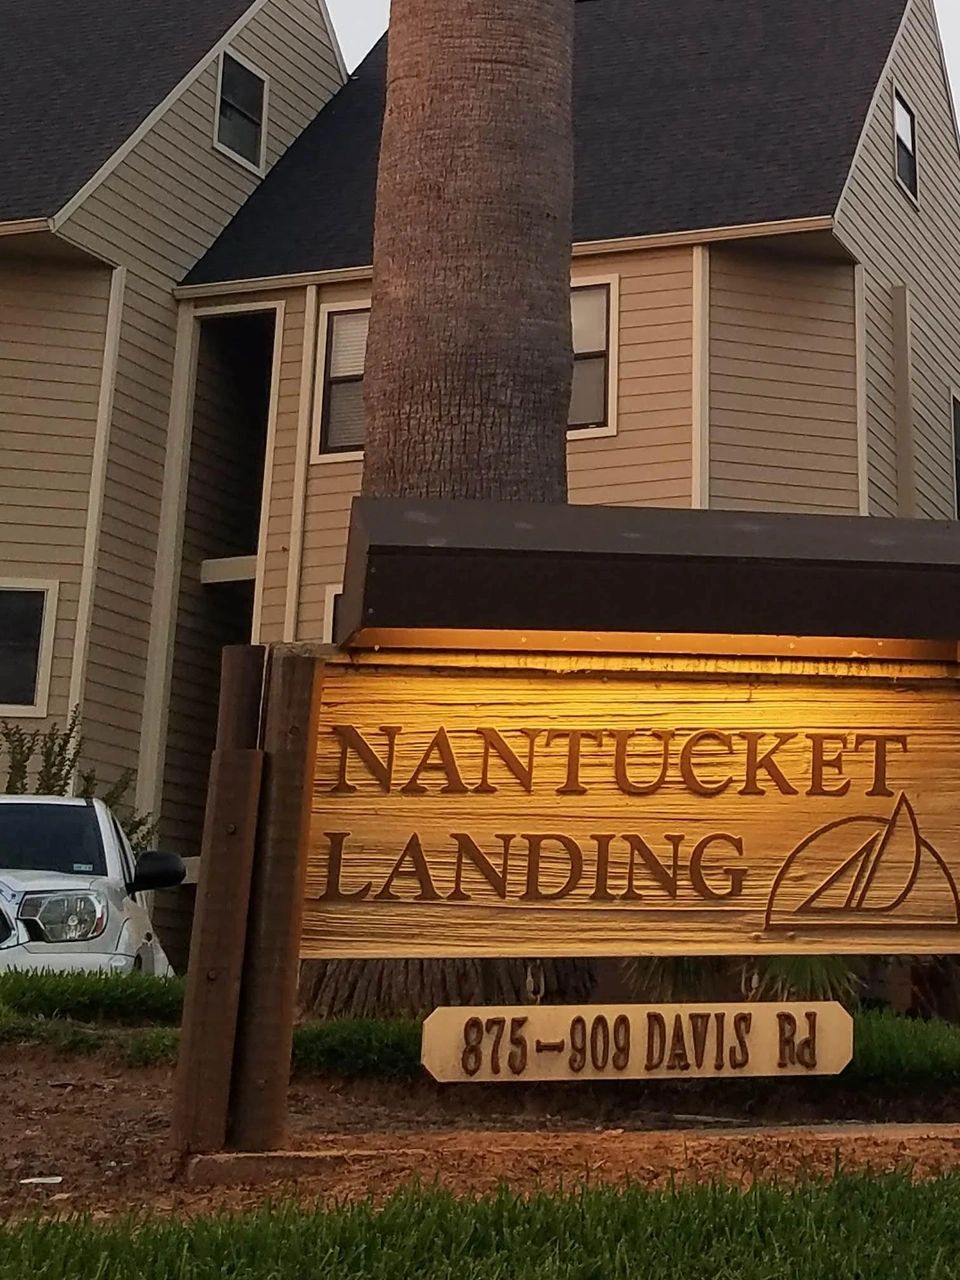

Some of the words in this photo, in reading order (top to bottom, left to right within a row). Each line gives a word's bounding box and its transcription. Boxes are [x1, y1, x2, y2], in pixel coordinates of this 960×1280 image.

[330, 724, 908, 798] NANTUCKET
[325, 831, 748, 902] LANDING
[644, 1011, 752, 1072] DAVIS
[776, 1011, 818, 1070] Rd
